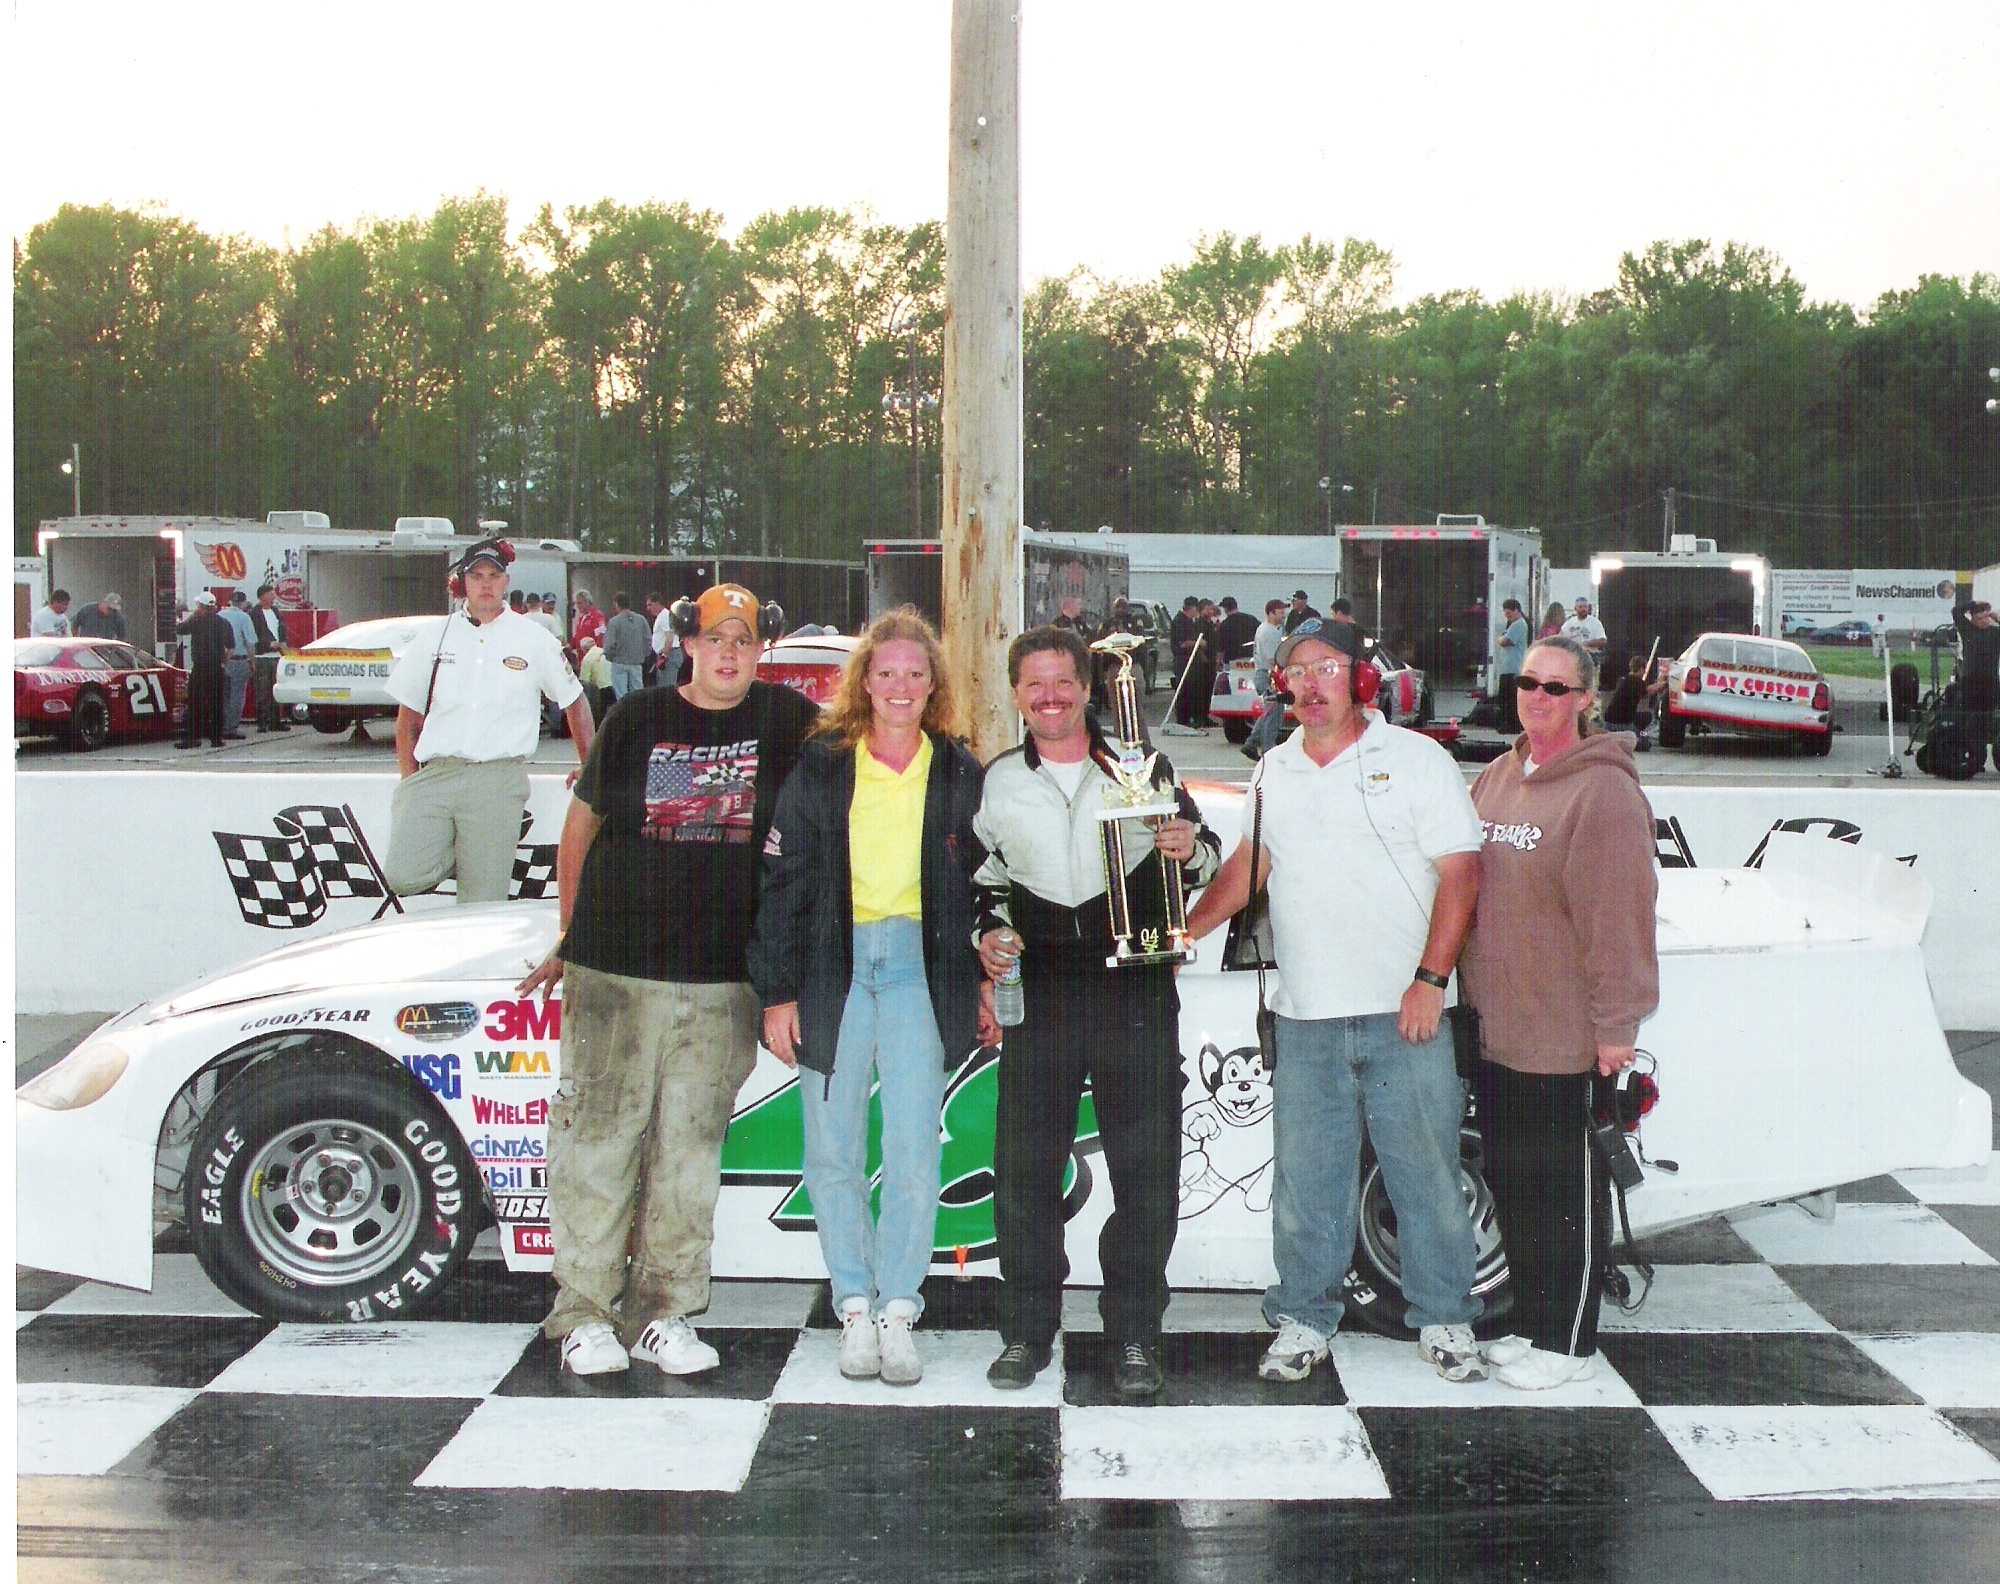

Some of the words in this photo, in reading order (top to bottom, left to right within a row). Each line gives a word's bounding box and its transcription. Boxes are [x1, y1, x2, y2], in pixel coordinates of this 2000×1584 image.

[723, 590, 749, 608] T
[1856, 585, 1936, 599] NewsChannel
[308, 663, 366, 677] CROSSROADS
[125, 674, 168, 714] 21
[1706, 673, 1739, 689] BAY
[1743, 677, 1810, 698] CUSTOM
[1720, 687, 1793, 702] AUTO
[648, 740, 758, 763] RACING
[1141, 927, 1159, 943] 04
[484, 999, 562, 1042] 3M
[474, 1051, 551, 1073] WM
[201, 1126, 245, 1225] EAGLE
